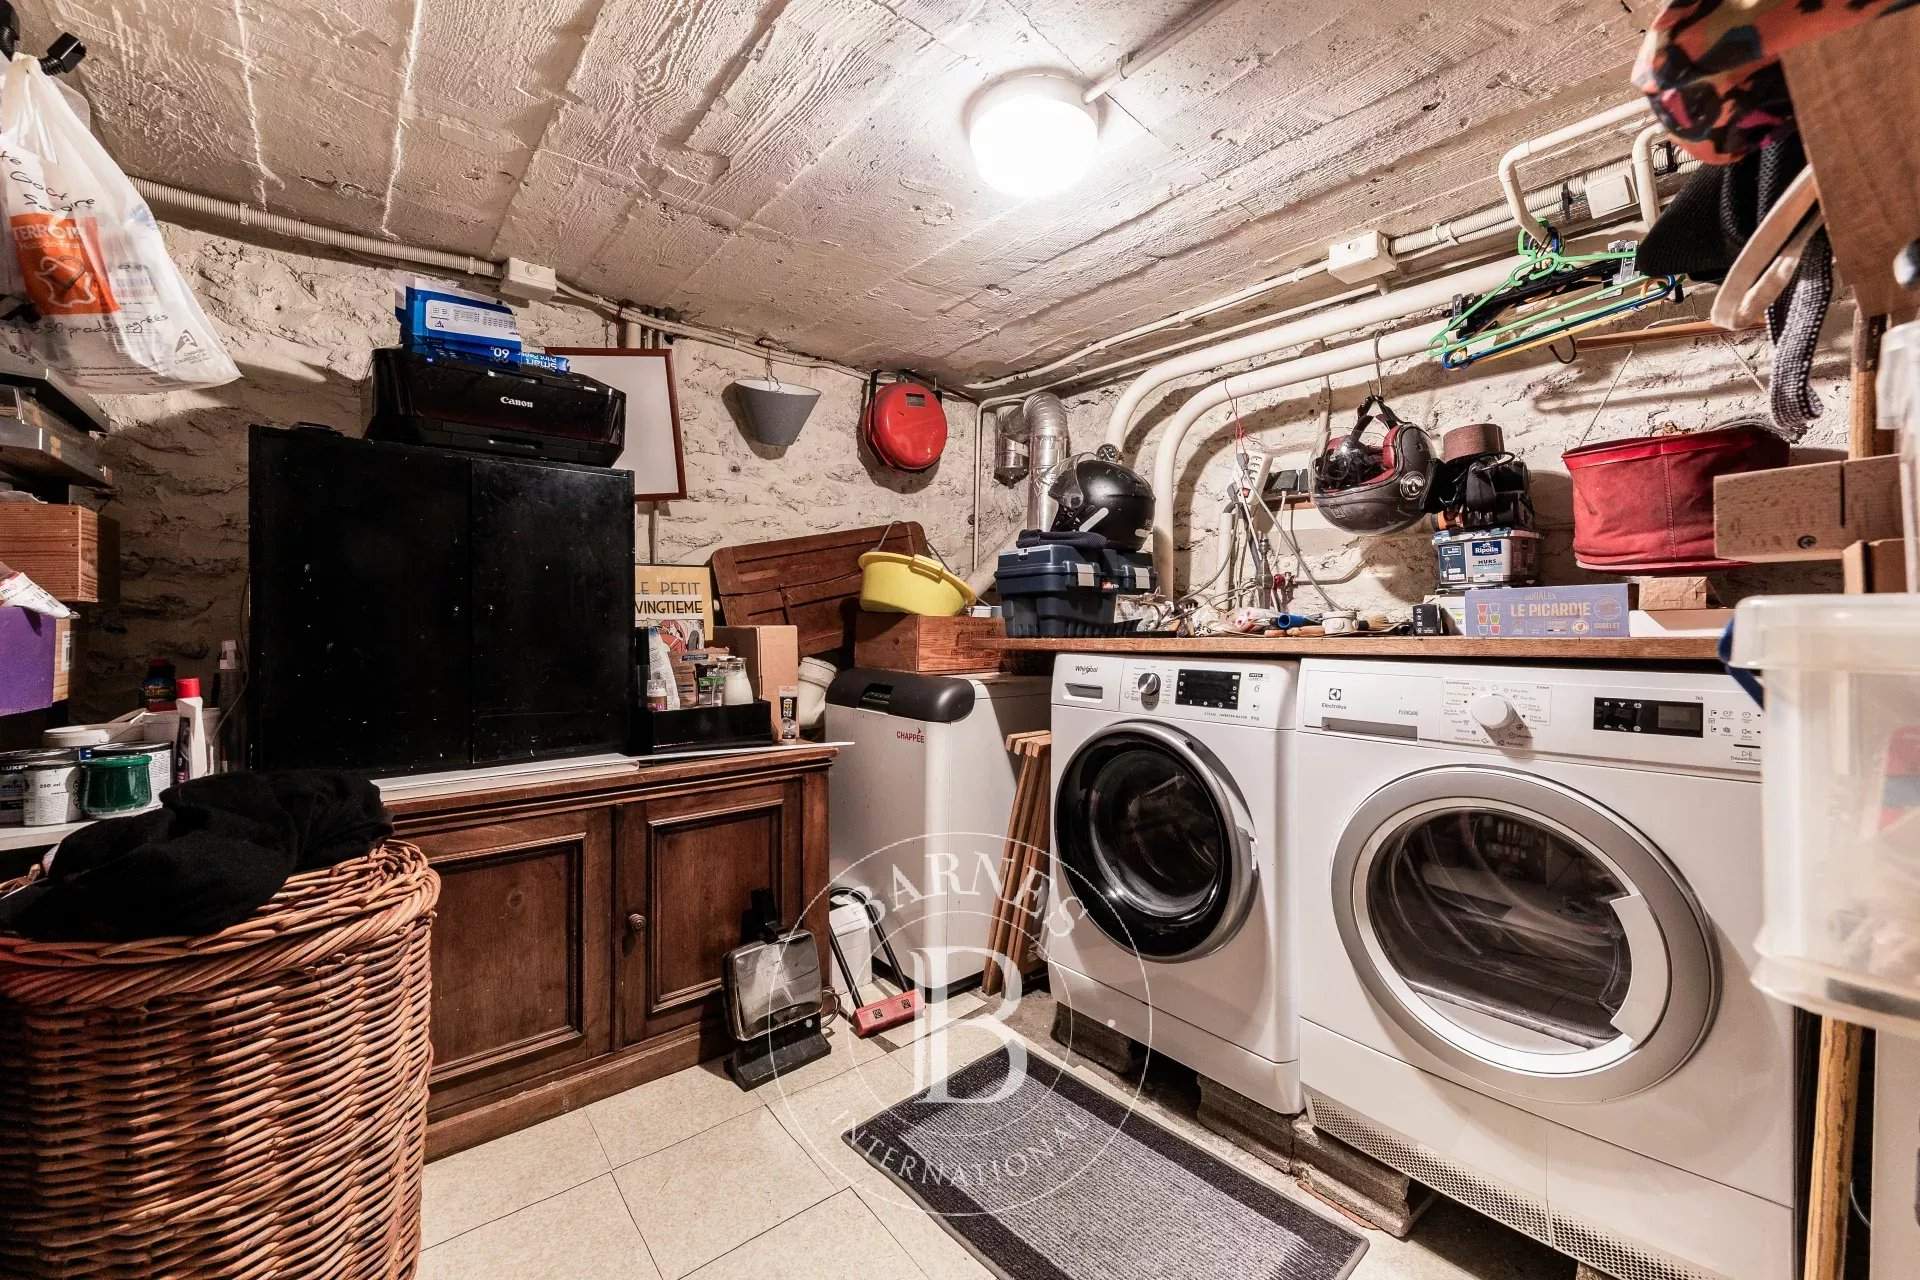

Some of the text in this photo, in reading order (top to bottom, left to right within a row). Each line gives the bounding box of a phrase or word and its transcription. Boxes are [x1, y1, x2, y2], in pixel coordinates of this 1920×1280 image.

[493, 346, 510, 359] 60
[500, 396, 534, 408] Canon
[635, 581, 701, 595] E PETIT
[635, 600, 704, 614] VINGTIEME
[1510, 602, 1592, 617] LE PICARDIE
[896, 728, 925, 743] CHAPPÉE
